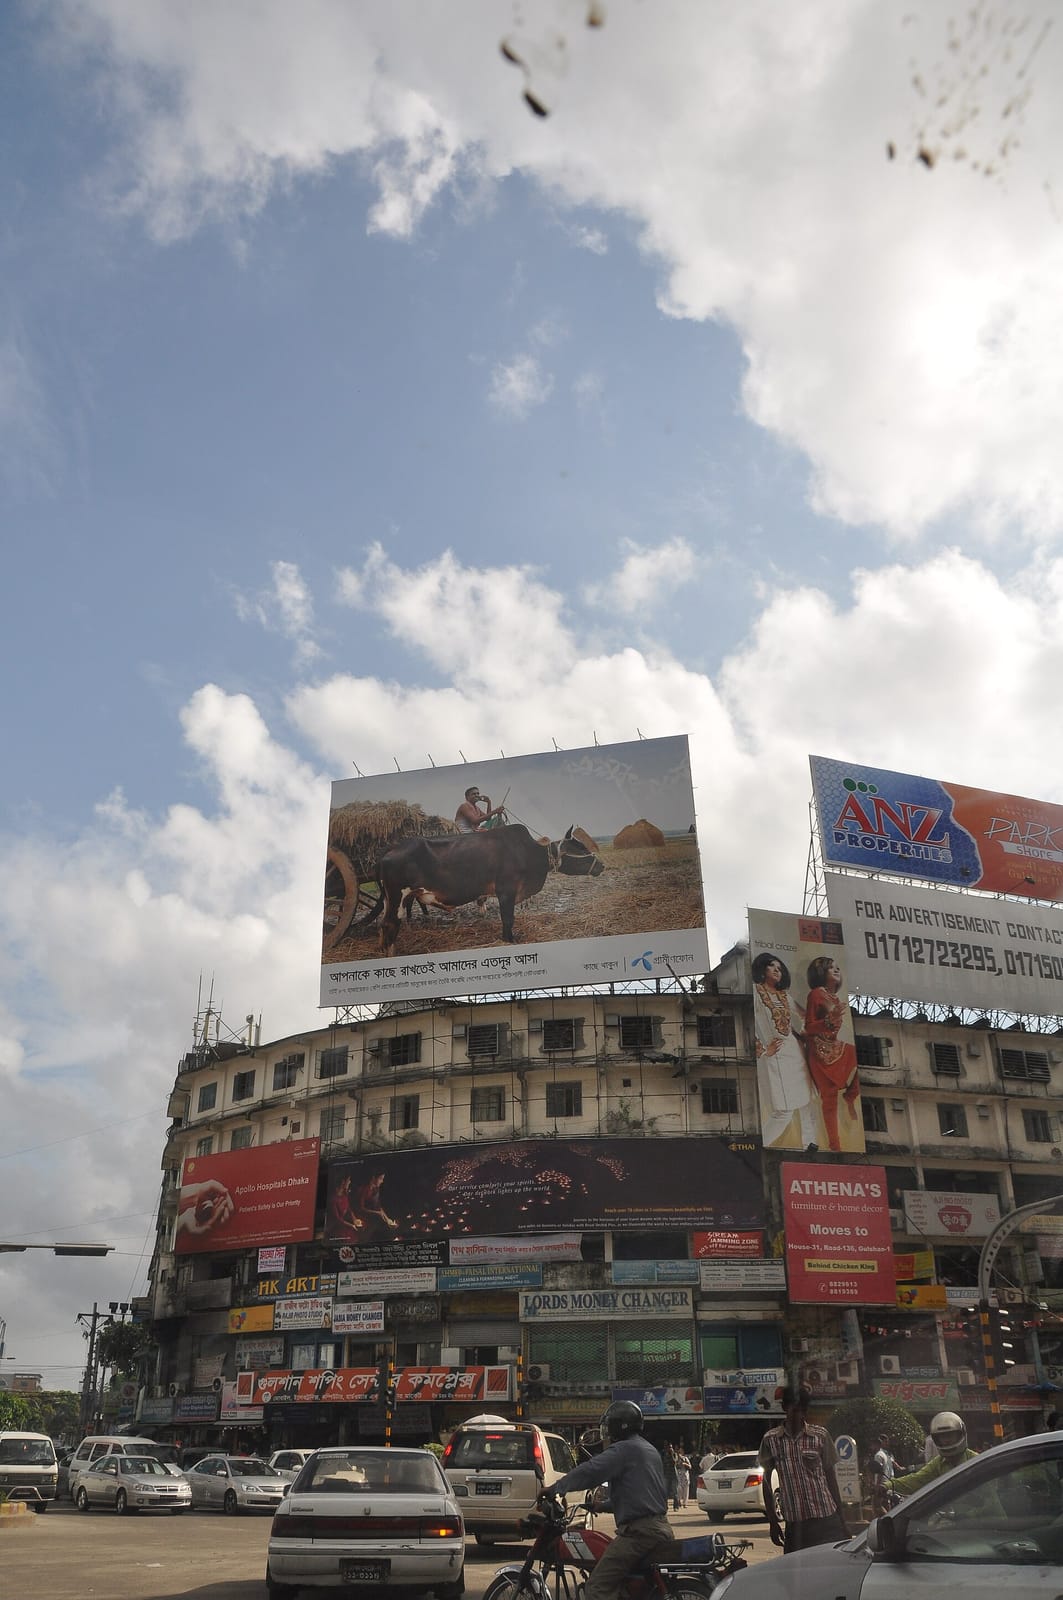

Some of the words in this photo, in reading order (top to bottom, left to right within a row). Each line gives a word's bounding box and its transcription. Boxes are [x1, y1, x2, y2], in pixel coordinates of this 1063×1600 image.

[833, 791, 951, 849] ANZ
[984, 816, 1063, 854] PARK
[833, 831, 953, 864] PROPERTIES
[855, 899, 885, 920] FOR
[889, 904, 1001, 937] ADVERTISEMENT
[1006, 922, 1063, 946] CONTAC
[329, 969, 371, 983] আপনাকে
[373, 967, 398, 979] কাছে
[400, 961, 436, 976] রাখতেই
[439, 959, 478, 972] আমাদের
[481, 955, 512, 970] এতদূর
[514, 953, 538, 965] আসা
[737, 1143, 755, 1151] THAI
[235, 1184, 256, 1197] Apollo
[257, 1180, 287, 1193] Hospitals
[288, 1176, 310, 1187] Dhaka
[790, 1180, 882, 1198] ATHENA'S
[791, 1201, 827, 1211] furniture
[828, 1202, 836, 1210] &
[838, 1202, 860, 1212] home
[861, 1204, 884, 1214] decor
[810, 1224, 851, 1237] Moves
[854, 1226, 869, 1237] to
[788, 1243, 822, 1251] House-31,
[807, 1262, 831, 1270] Behind
[832, 1263, 859, 1271] Chicken
[860, 1263, 875, 1273] King
[258, 1280, 280, 1297] HK
[286, 1276, 319, 1294] ART
[524, 1294, 568, 1311] LORDS
[570, 1292, 619, 1309] MONEY
[621, 1291, 689, 1308] CHANGER
[346, 1312, 361, 1321] MONEY
[362, 1311, 382, 1320] CHANGER
[258, 1376, 304, 1392] গুলশান
[309, 1370, 343, 1392] শপিং
[408, 1371, 477, 1391] কমপ্লেক্স
